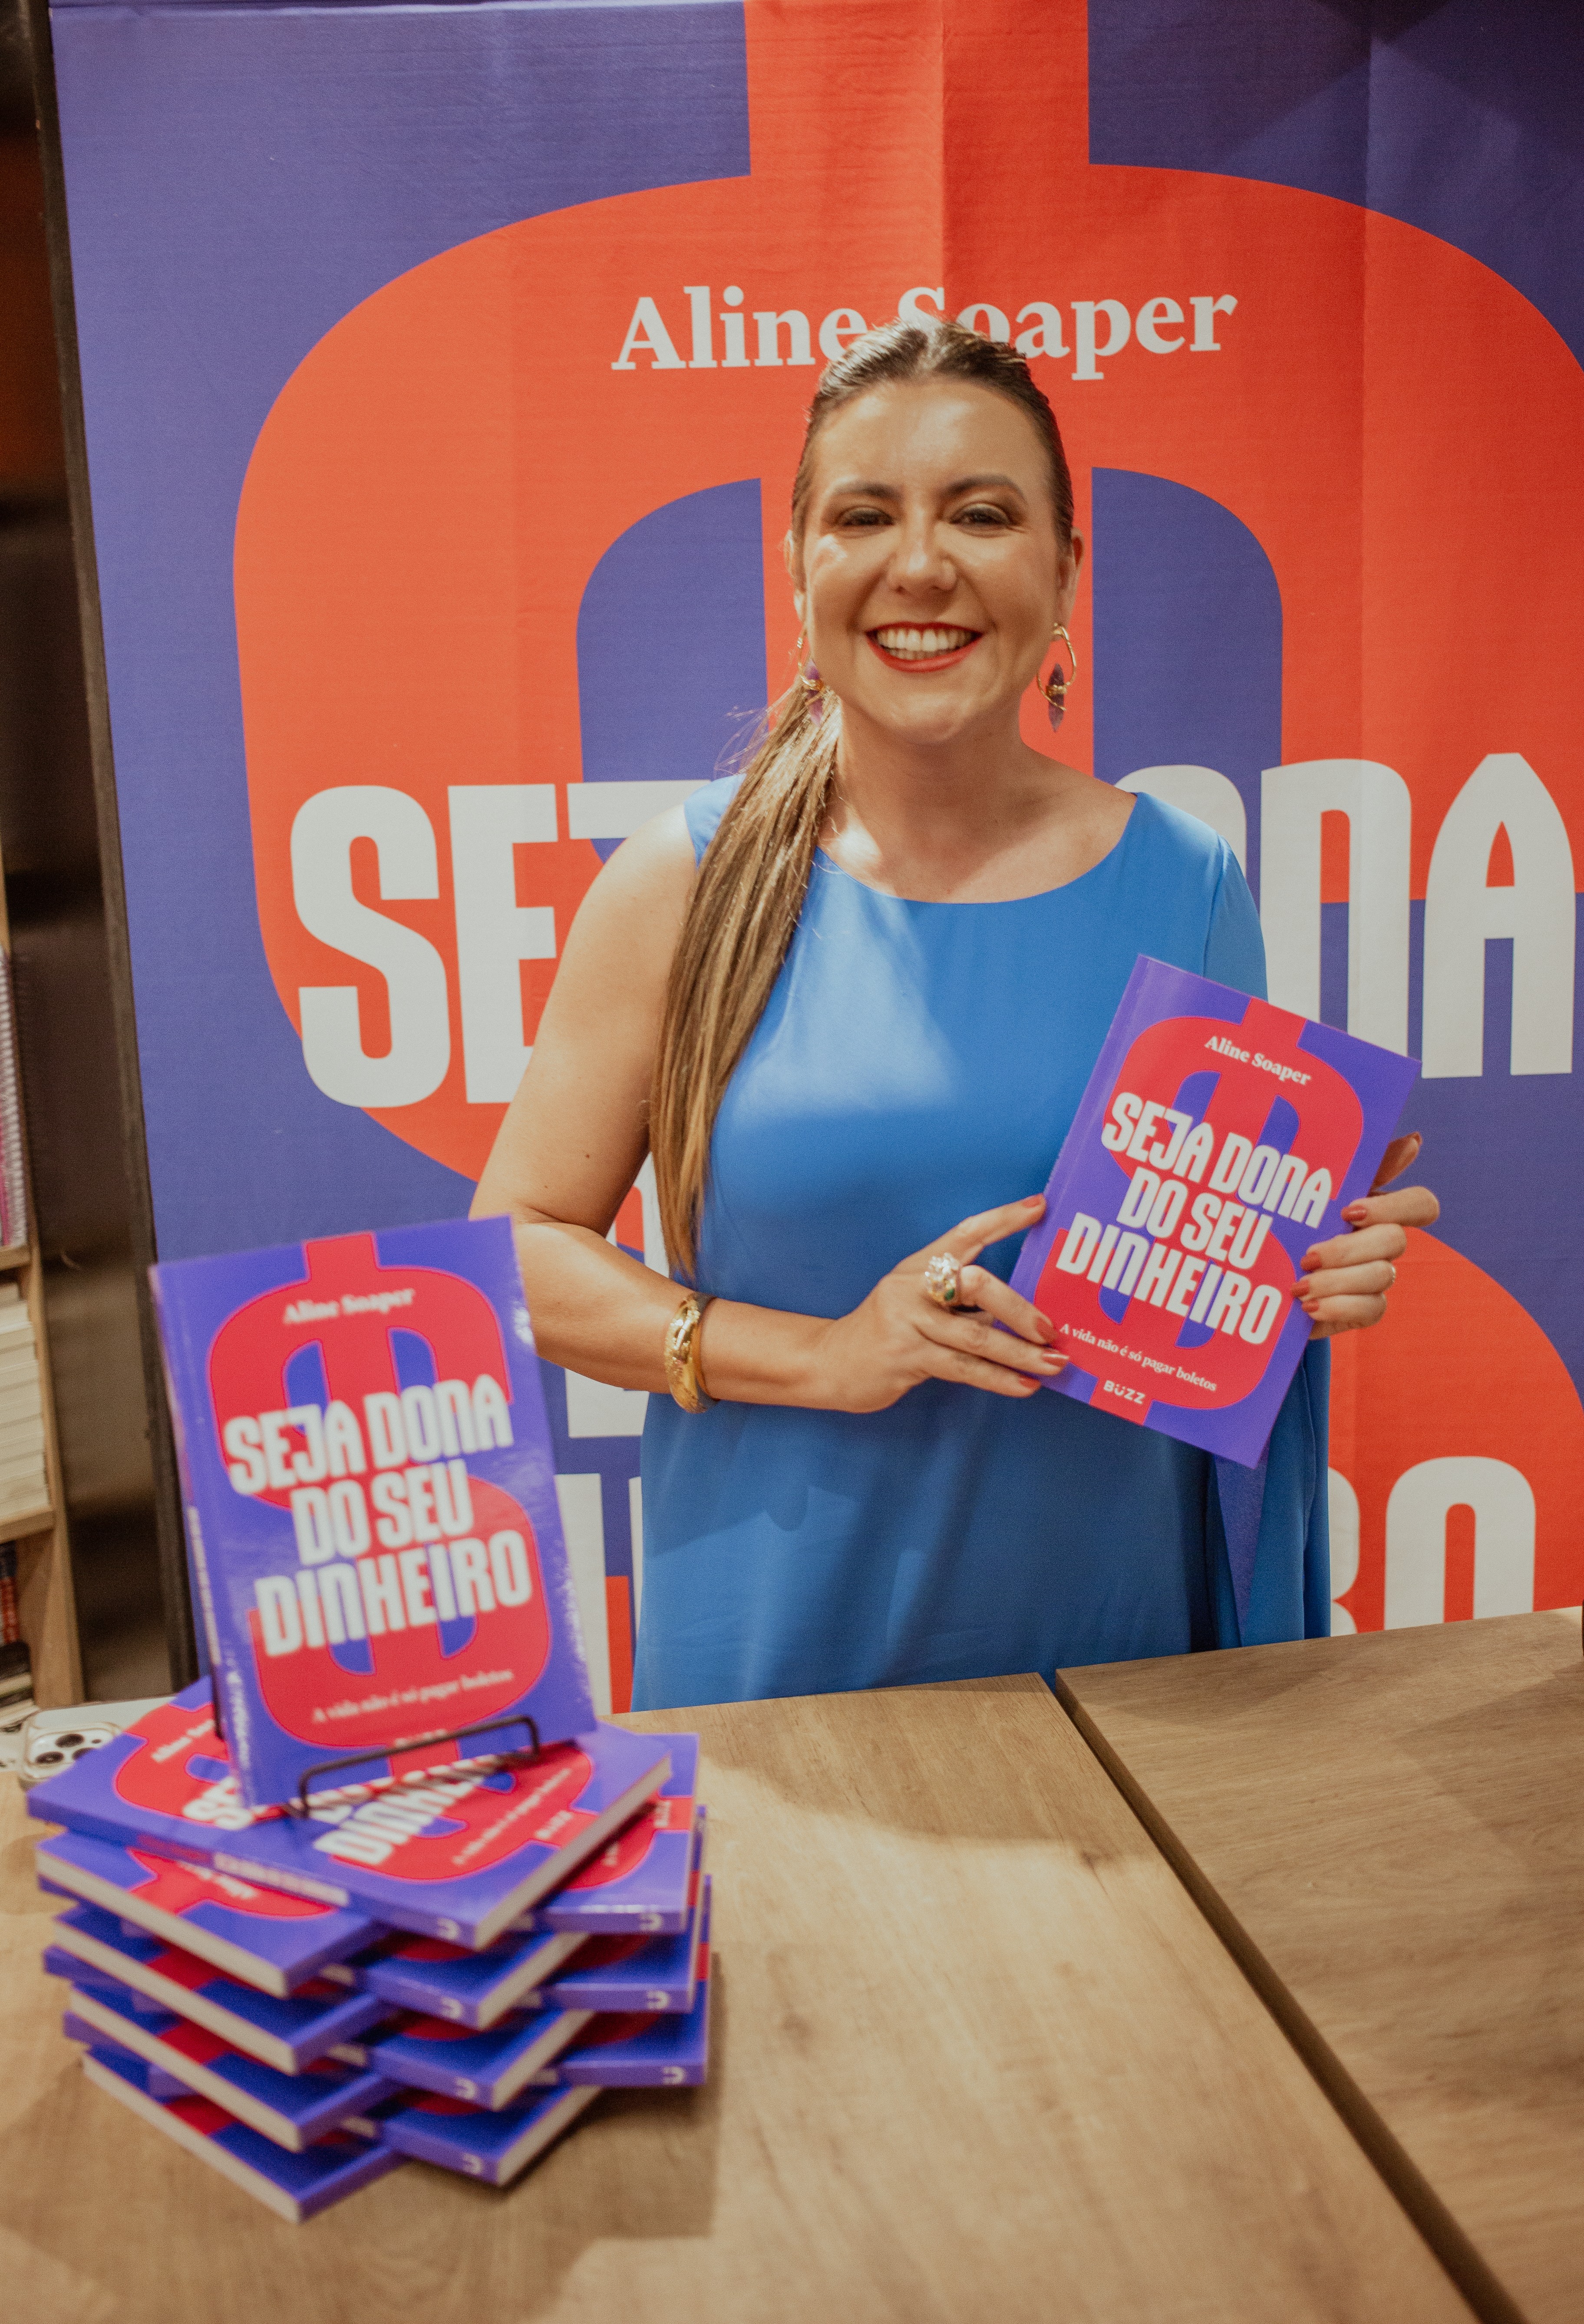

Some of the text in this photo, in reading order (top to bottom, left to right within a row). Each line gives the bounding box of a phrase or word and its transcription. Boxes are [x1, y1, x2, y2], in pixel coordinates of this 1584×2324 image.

[611, 285, 867, 370] Aline
[1204, 1036, 1312, 1085] Aline Soaper
[1101, 1092, 1332, 1229] SEJA DONA
[1116, 1166, 1273, 1269] DO SEU
[1056, 1212, 1282, 1344] DINHEIRO
[1059, 1323, 1217, 1391] A vida não é só pagar boletos
[224, 1400, 367, 1495] SEJA
[363, 1374, 514, 1469] DONA
[290, 1458, 474, 1566] DO SEU
[254, 1530, 532, 1657] DINHEIRO
